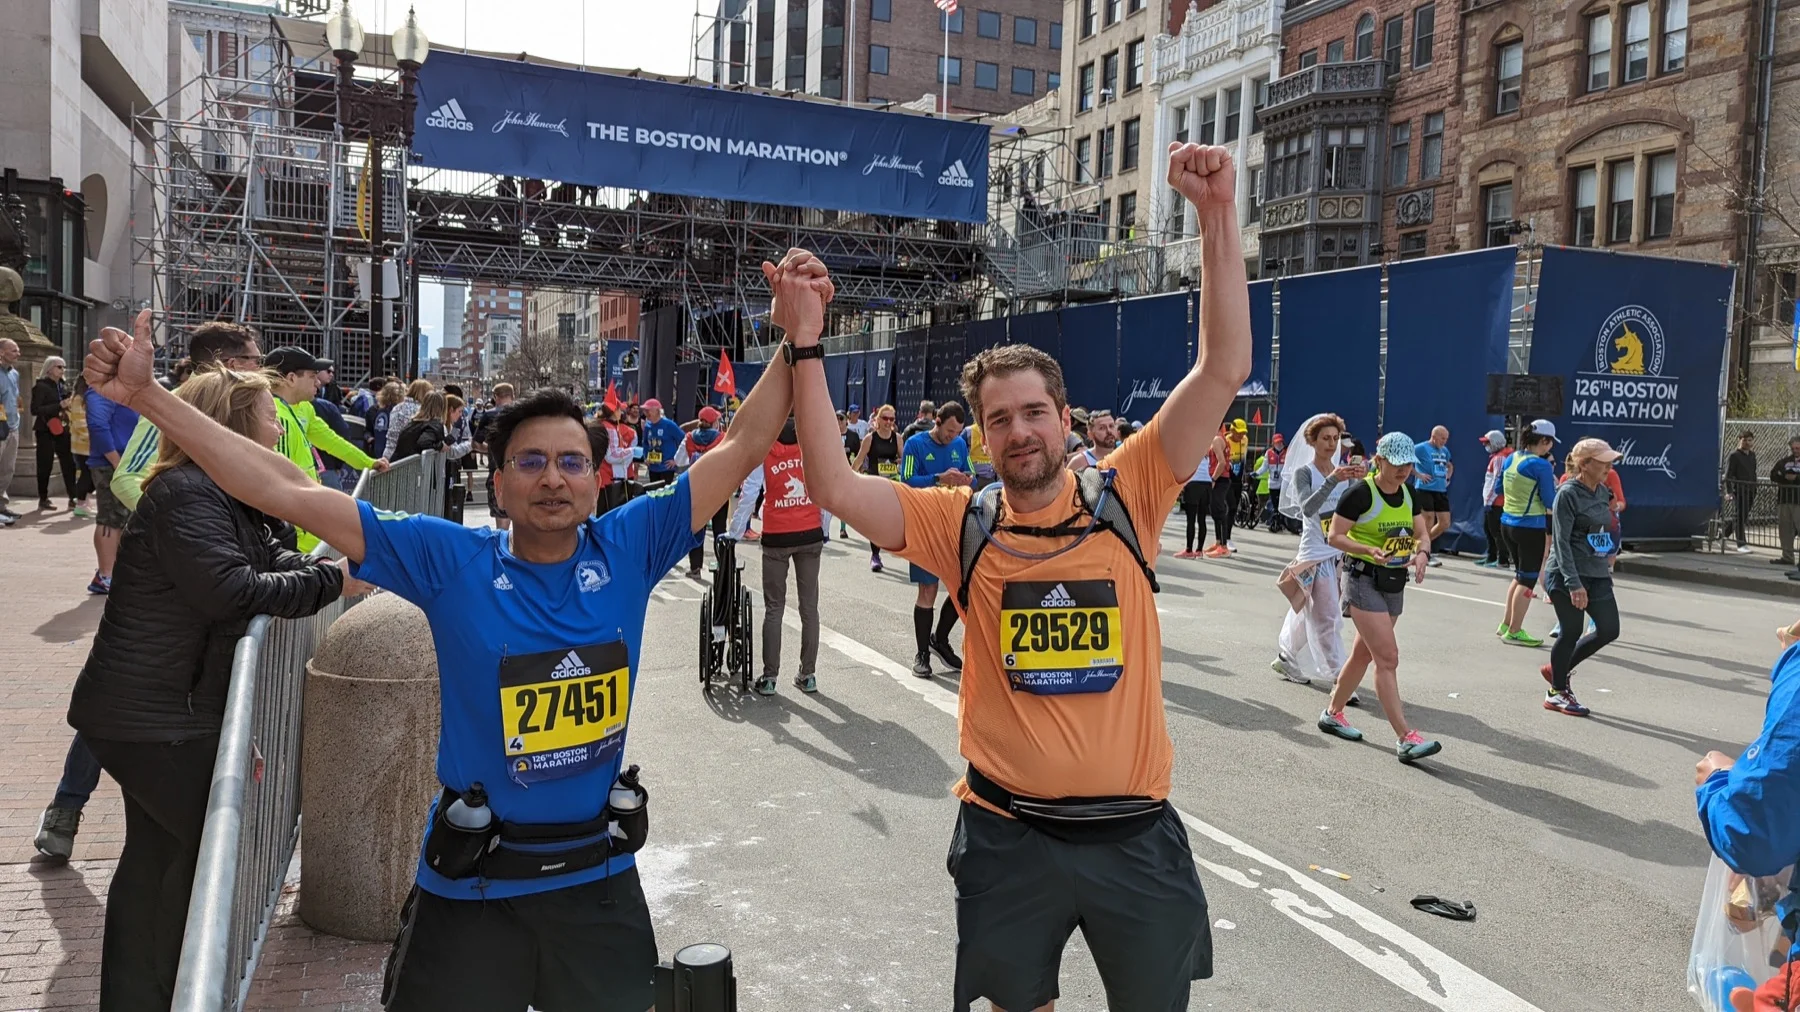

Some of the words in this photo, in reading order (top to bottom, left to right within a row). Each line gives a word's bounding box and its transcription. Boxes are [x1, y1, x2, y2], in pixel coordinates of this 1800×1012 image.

[425, 116, 474, 132] adidas
[586, 122, 629, 143] THE
[635, 127, 721, 153] BOSTON
[938, 175, 974, 188] adidas
[1598, 328, 1610, 369] BOSTON
[1609, 308, 1642, 329] ATHLETIC
[1641, 313, 1662, 373] ASSOCIATION
[1575, 378, 1611, 397] 126TH
[1612, 381, 1678, 400] BOSTON
[771, 459, 803, 475] BOST
[774, 496, 812, 508] MEDICA
[1041, 598, 1077, 608] adidas
[1010, 611, 1110, 652] 29529
[1005, 654, 1015, 666] 6
[551, 665, 591, 679] adidas
[515, 675, 617, 735] 27451
[509, 737, 523, 751] 4
[553, 746, 588, 760] BOSTON
